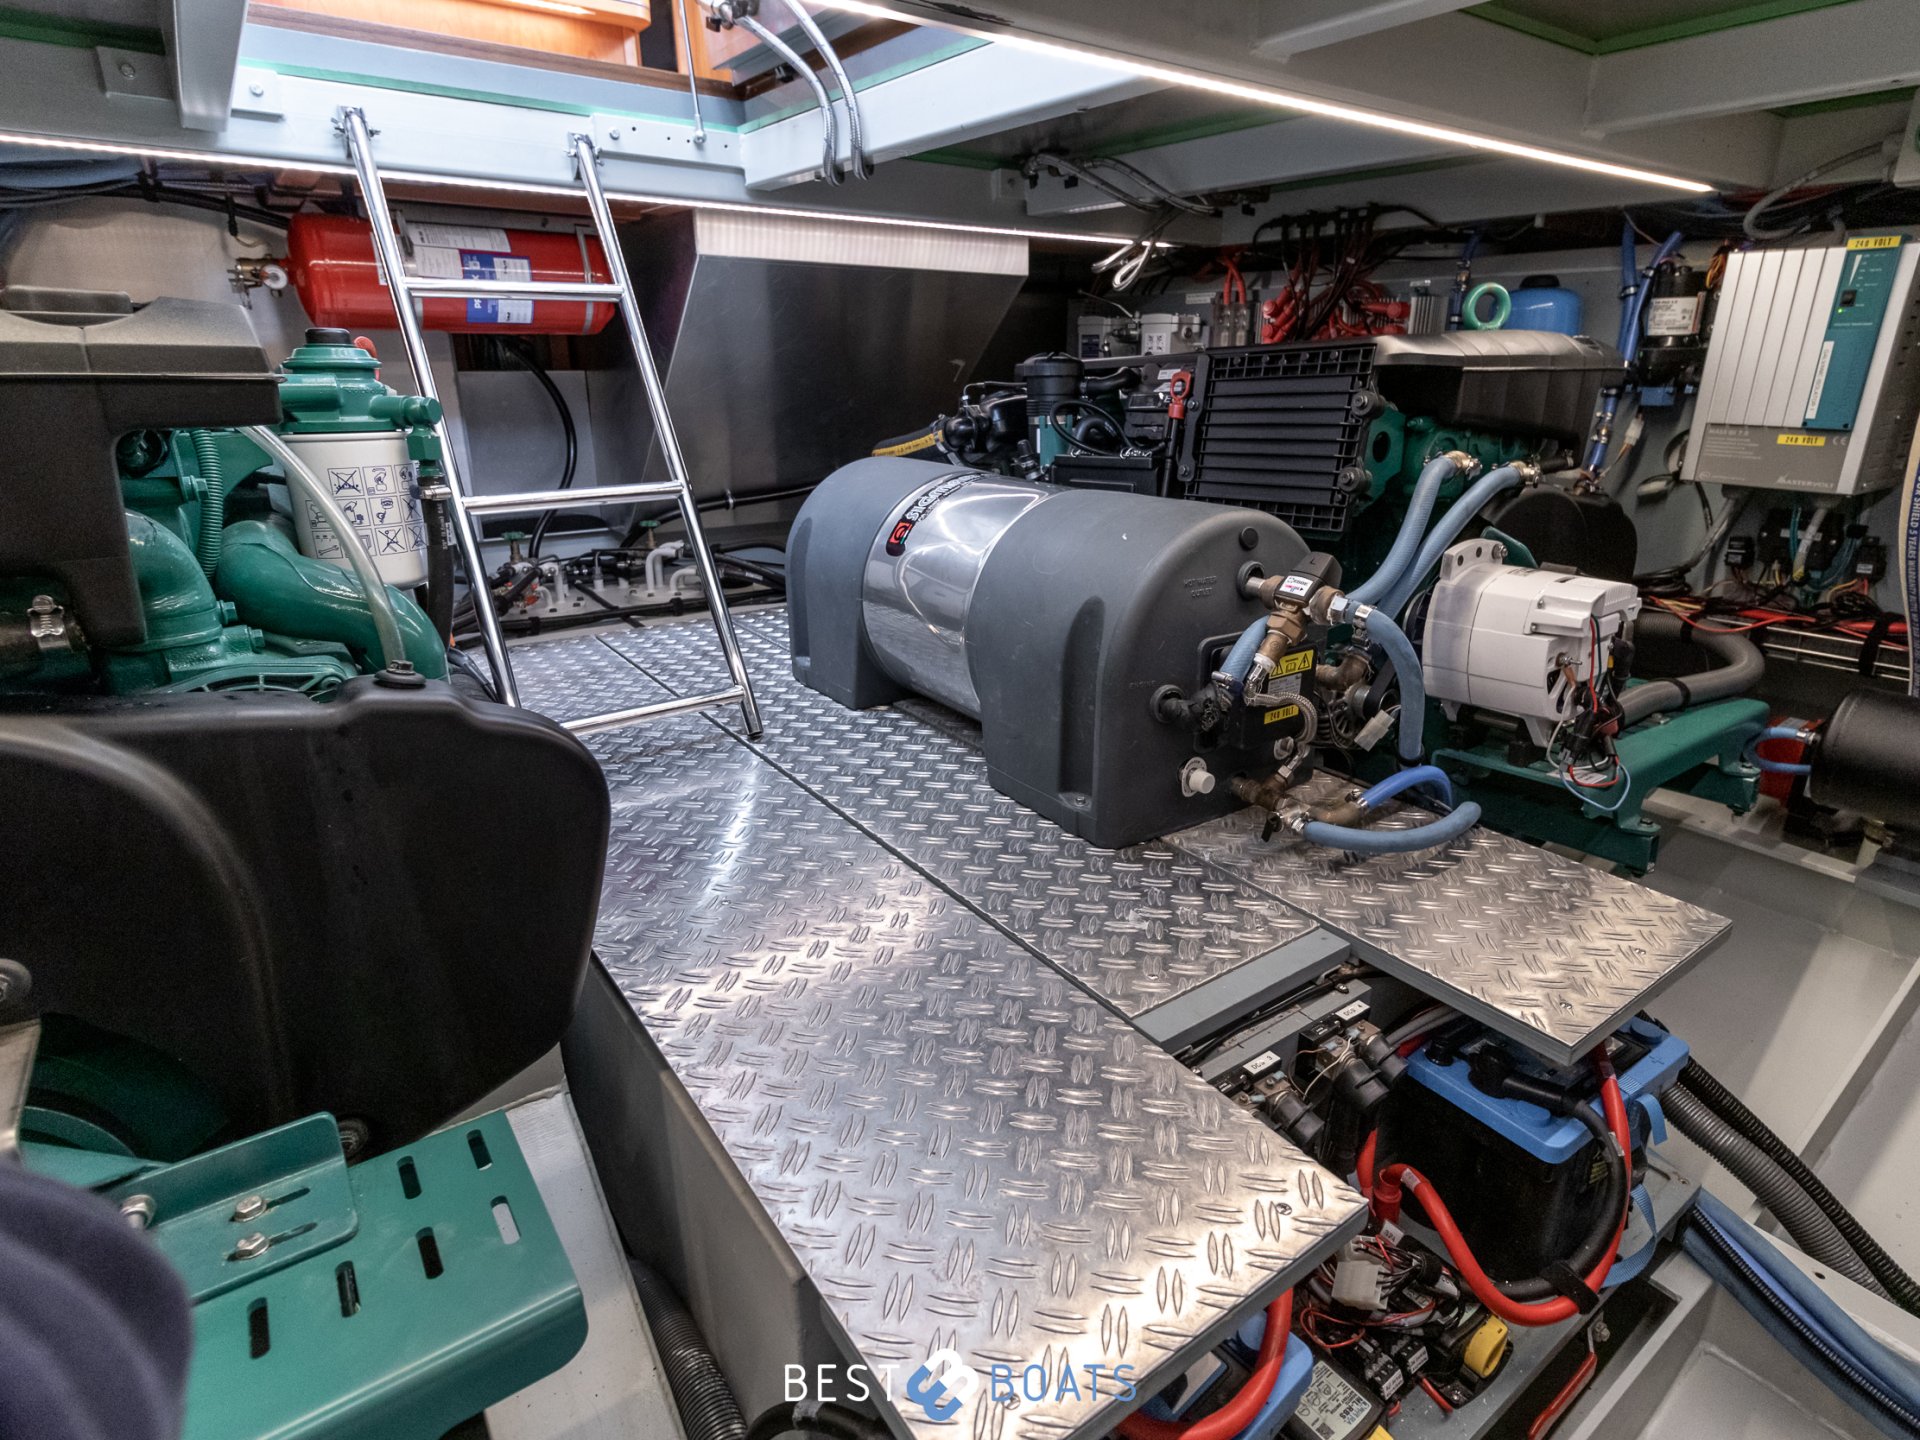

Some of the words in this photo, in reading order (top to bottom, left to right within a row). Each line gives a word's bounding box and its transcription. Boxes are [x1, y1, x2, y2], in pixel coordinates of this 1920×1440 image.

[1873, 237, 1892, 246] VOLT
[1802, 436, 1819, 445] VOLT
[1776, 473, 1835, 489] MASTERVOLT
[1909, 497, 1920, 528] SHIELD
[1907, 536, 1917, 559] YEARS
[1282, 706, 1294, 717] VOLT
[1339, 1395, 1363, 1420] ML-RBS
